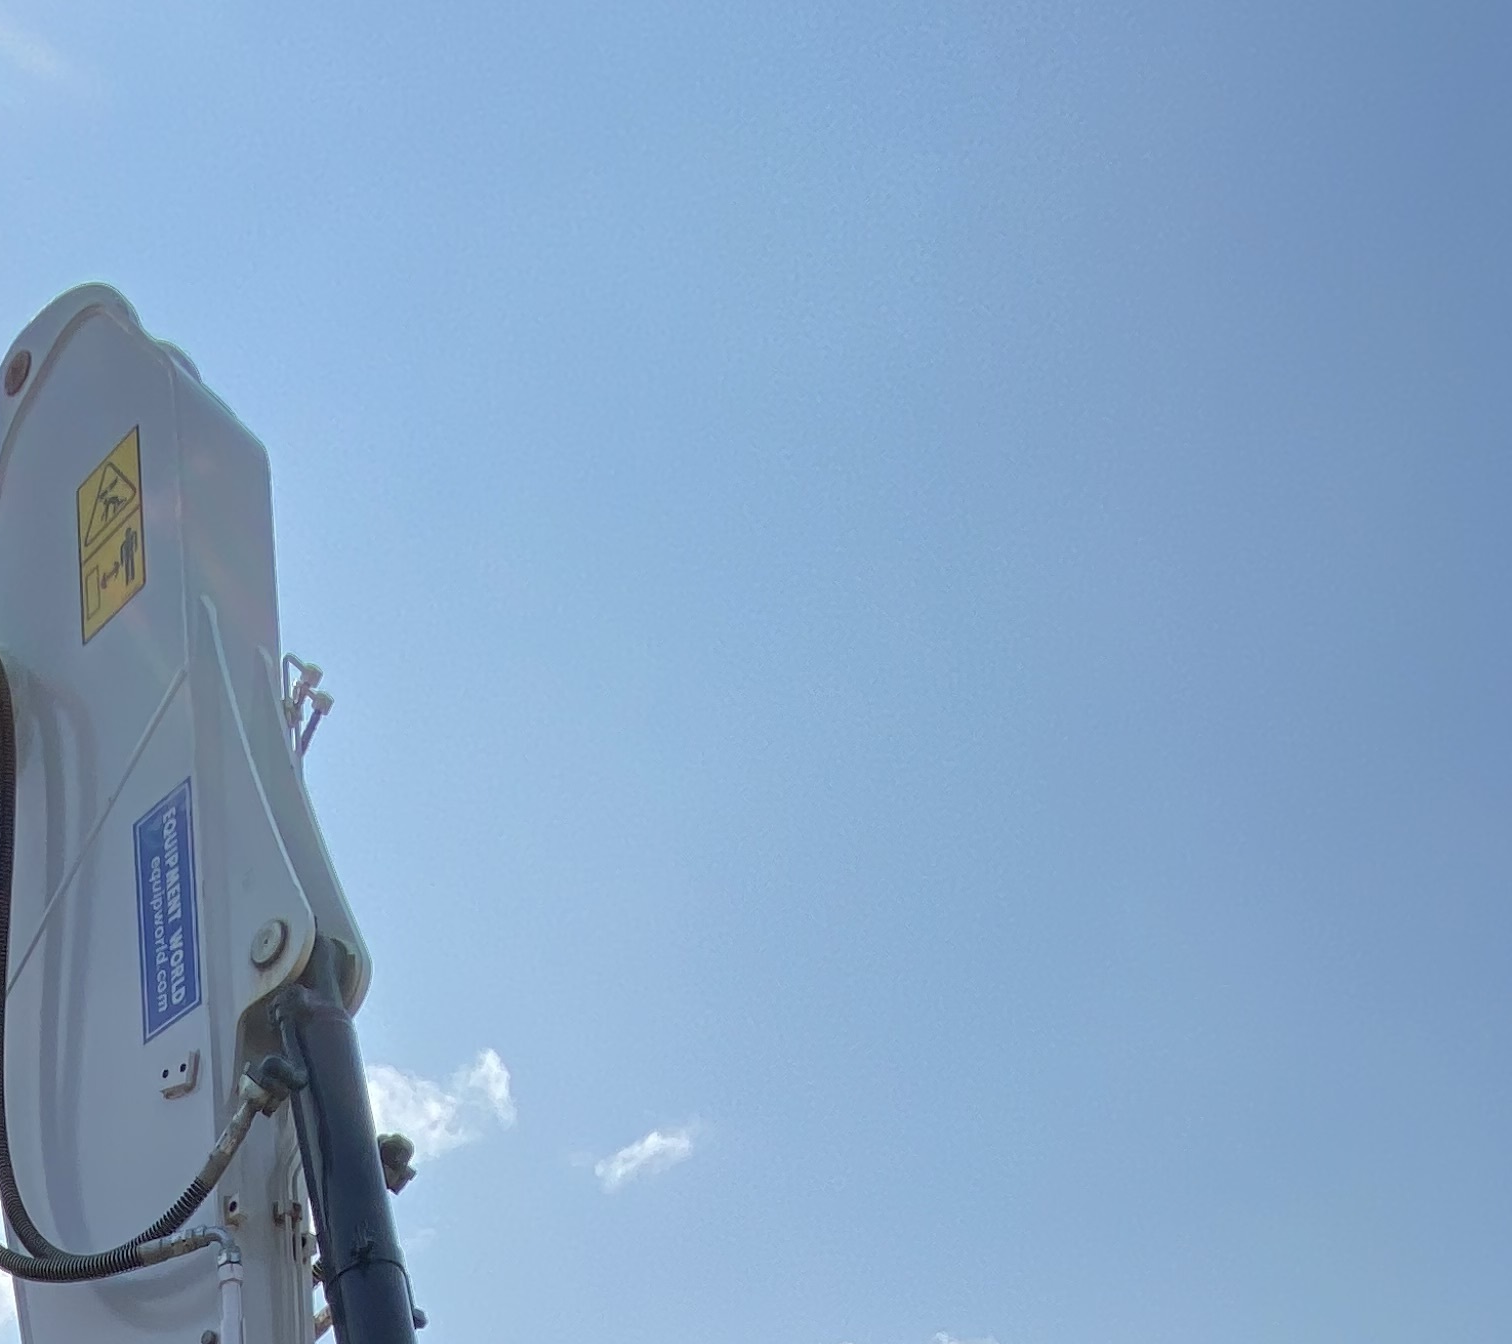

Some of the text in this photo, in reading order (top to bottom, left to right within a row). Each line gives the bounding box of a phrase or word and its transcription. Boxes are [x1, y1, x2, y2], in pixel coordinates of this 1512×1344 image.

[148, 855, 168, 1012] equipworld.com
[162, 805, 186, 1006] EQUIPMENT WORLD
